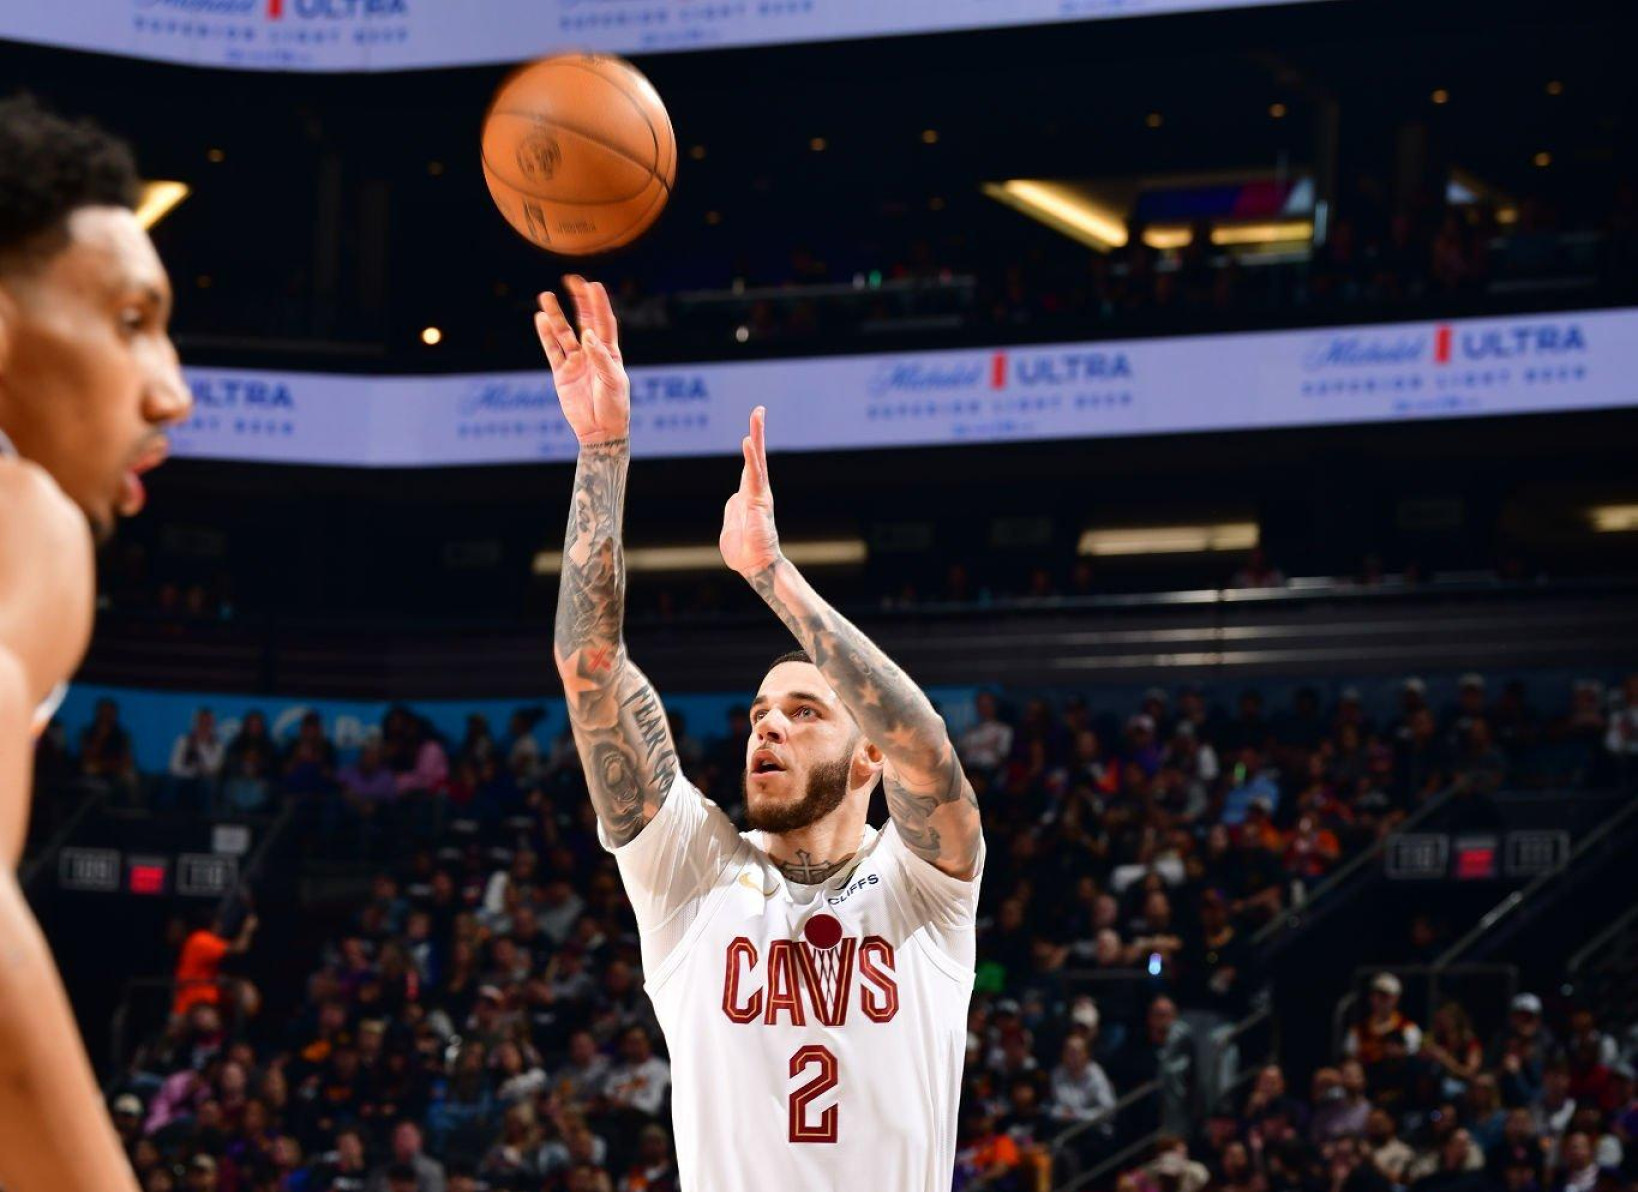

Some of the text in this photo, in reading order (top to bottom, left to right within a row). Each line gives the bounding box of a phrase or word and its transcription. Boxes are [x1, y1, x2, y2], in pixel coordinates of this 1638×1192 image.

[1461, 324, 1585, 360] ULTRA
[1016, 350, 1132, 387] ULTRA
[827, 873, 879, 905] CLIFFS
[721, 935, 900, 1027] CAVS
[789, 1044, 838, 1143] 2
